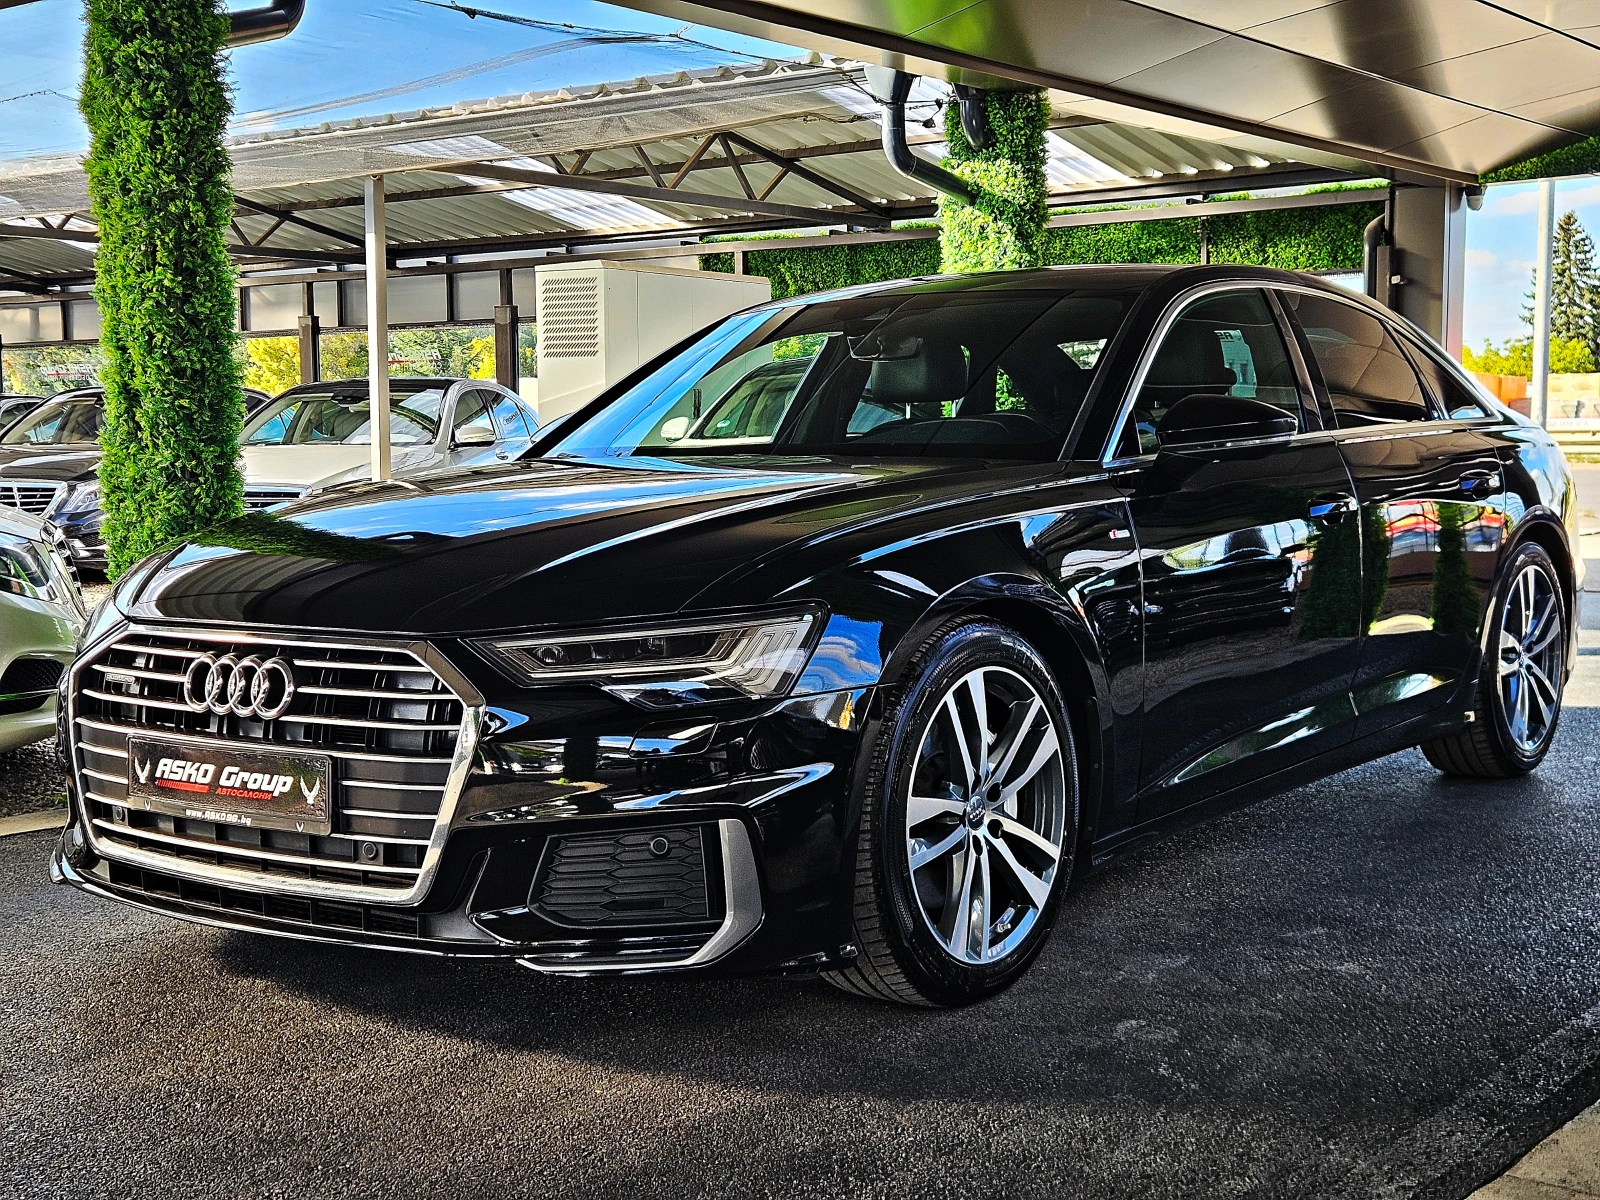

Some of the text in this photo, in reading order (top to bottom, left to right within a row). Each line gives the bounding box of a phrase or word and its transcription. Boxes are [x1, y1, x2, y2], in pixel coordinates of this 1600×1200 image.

[155, 758, 294, 797] ASKO Group
[215, 787, 273, 800] АВТОСАЛОНИ
